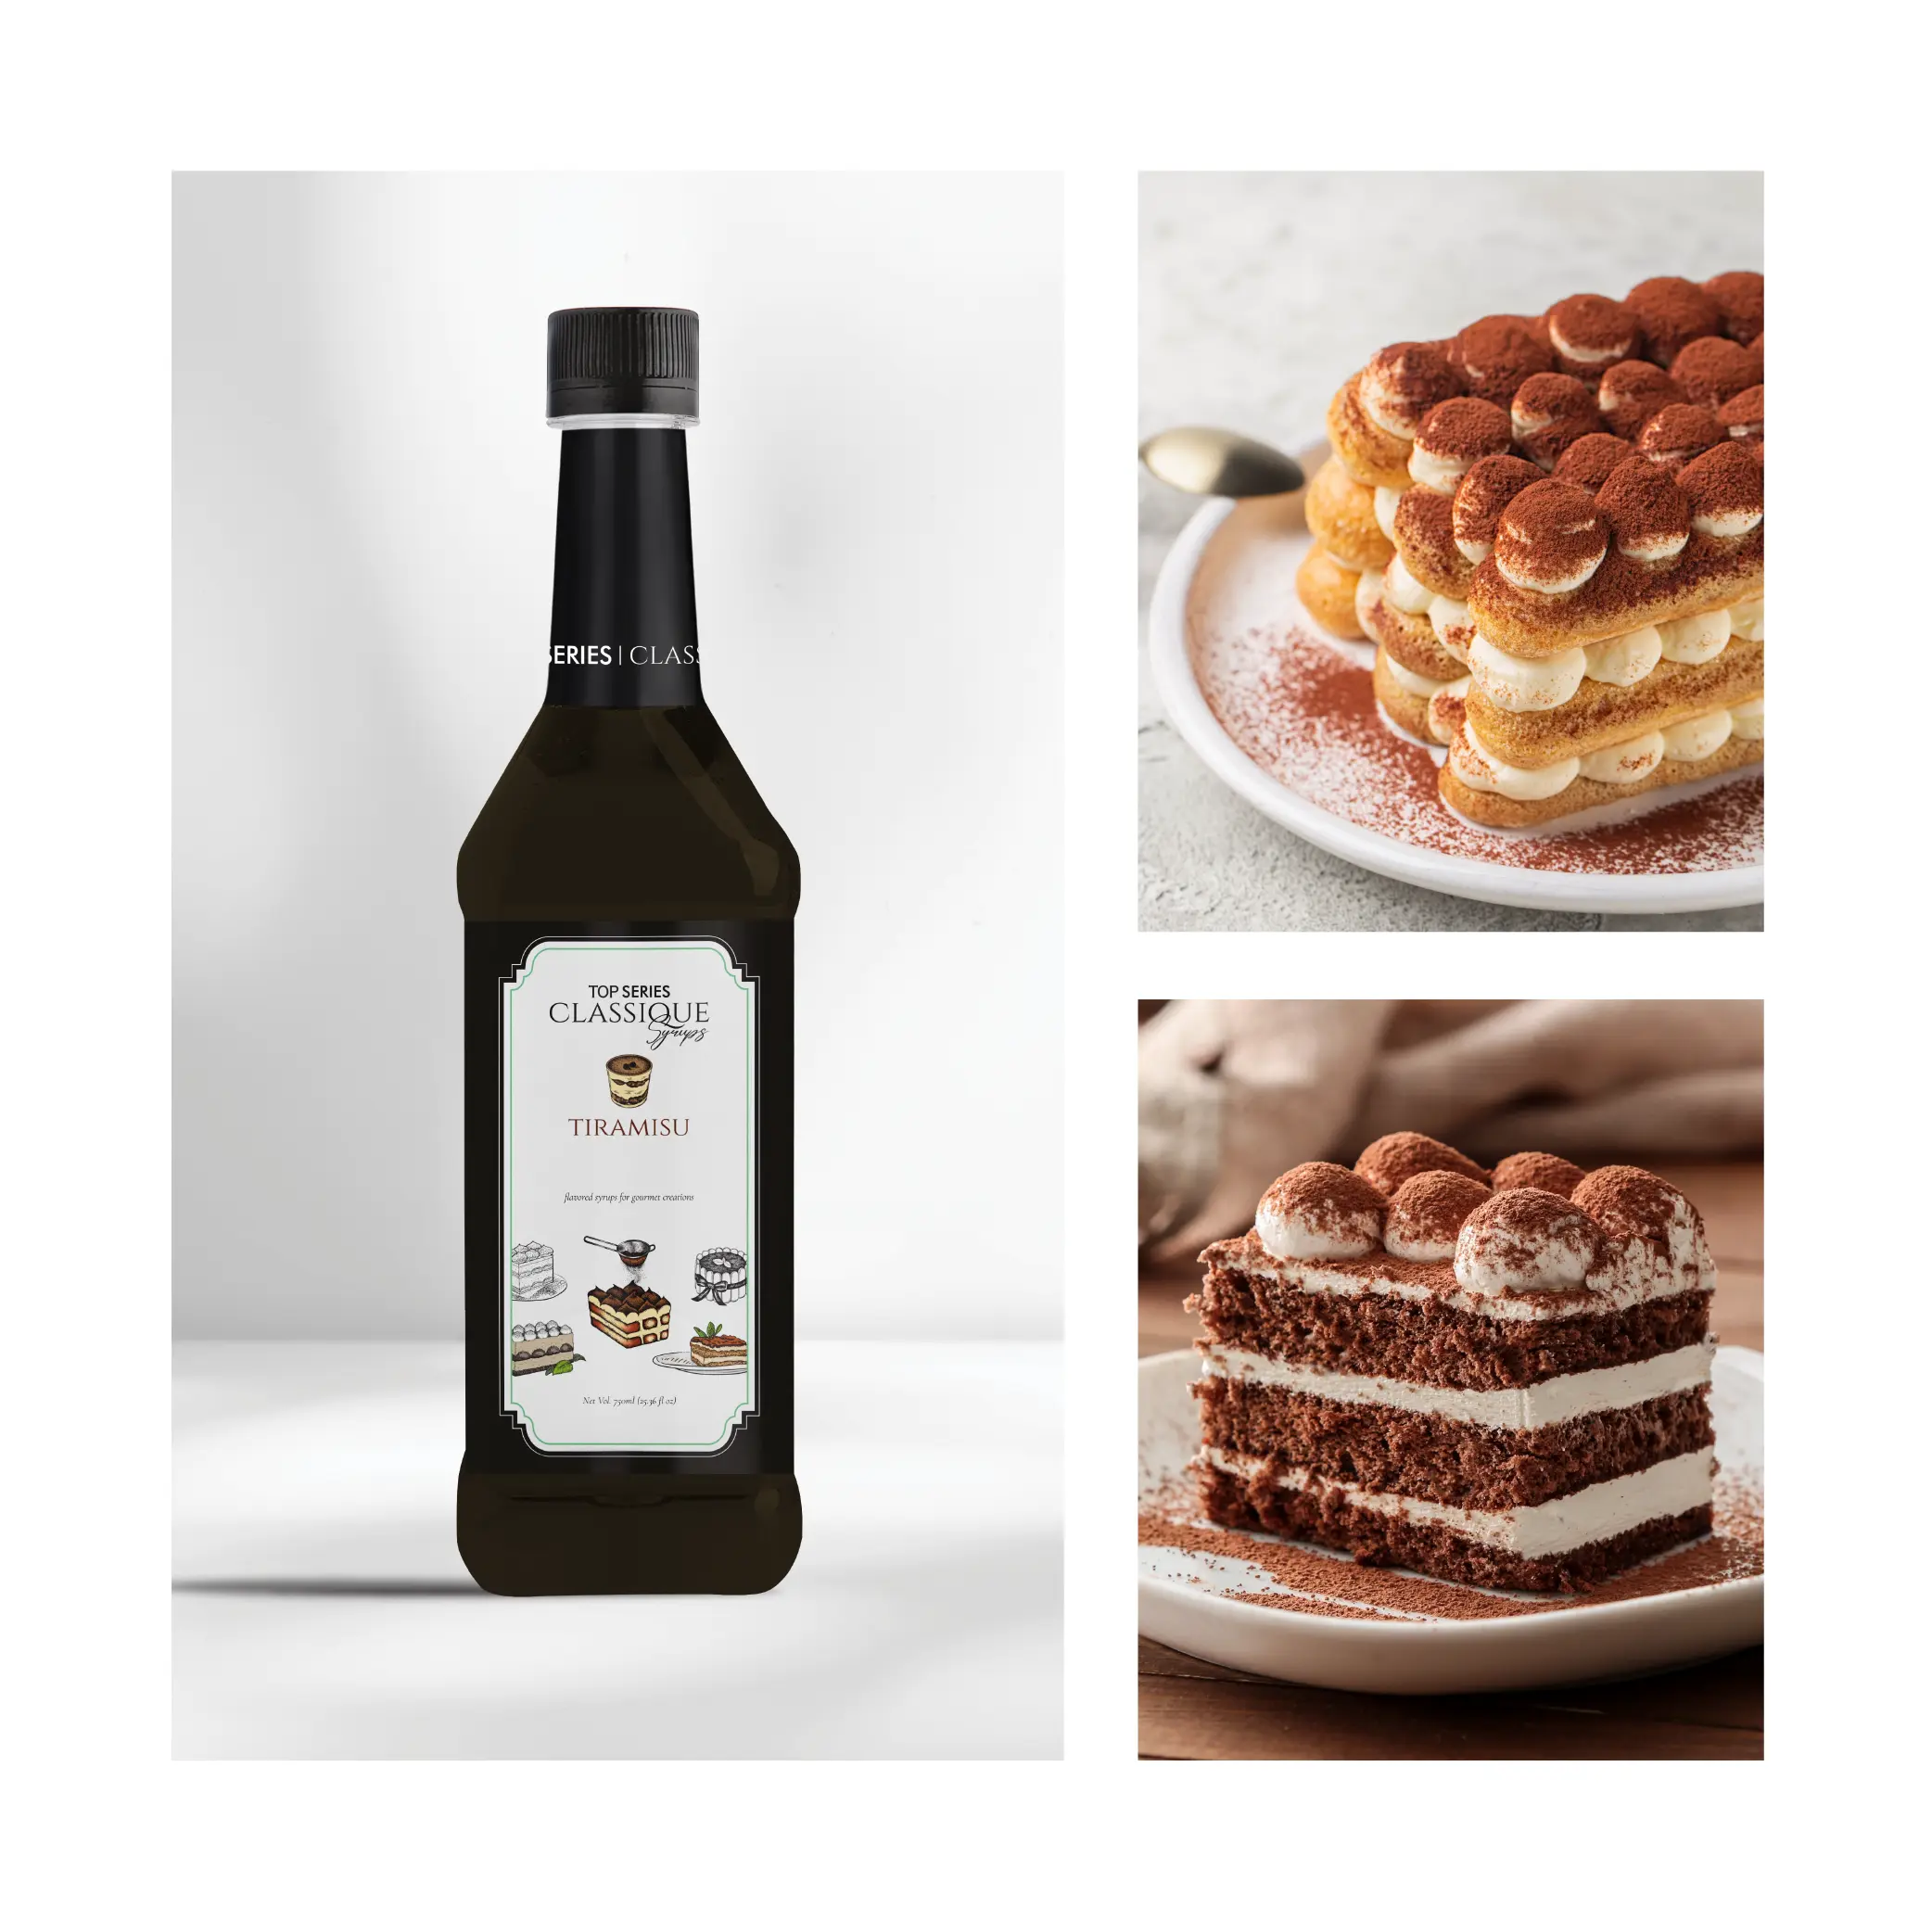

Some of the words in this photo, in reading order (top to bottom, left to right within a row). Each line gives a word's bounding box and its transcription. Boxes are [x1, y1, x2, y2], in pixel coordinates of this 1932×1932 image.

[589, 985, 618, 998] TOP
[622, 985, 670, 998] SERIES
[549, 1002, 710, 1027] CLASSIQUE
[646, 1014, 709, 1051] Syrups
[568, 1118, 690, 1137] TIRAMISU
[564, 1192, 593, 1203] flavored
[594, 1194, 617, 1203] syrups
[618, 1192, 630, 1203] for
[631, 1194, 660, 1203] gourmet
[662, 1193, 694, 1202] creations
[582, 1396, 595, 1405] Net
[613, 1396, 635, 1407] 750ml
[637, 1396, 656, 1407] (25.36
[657, 1396, 665, 1407] fl
[665, 1396, 677, 1405] oz)
